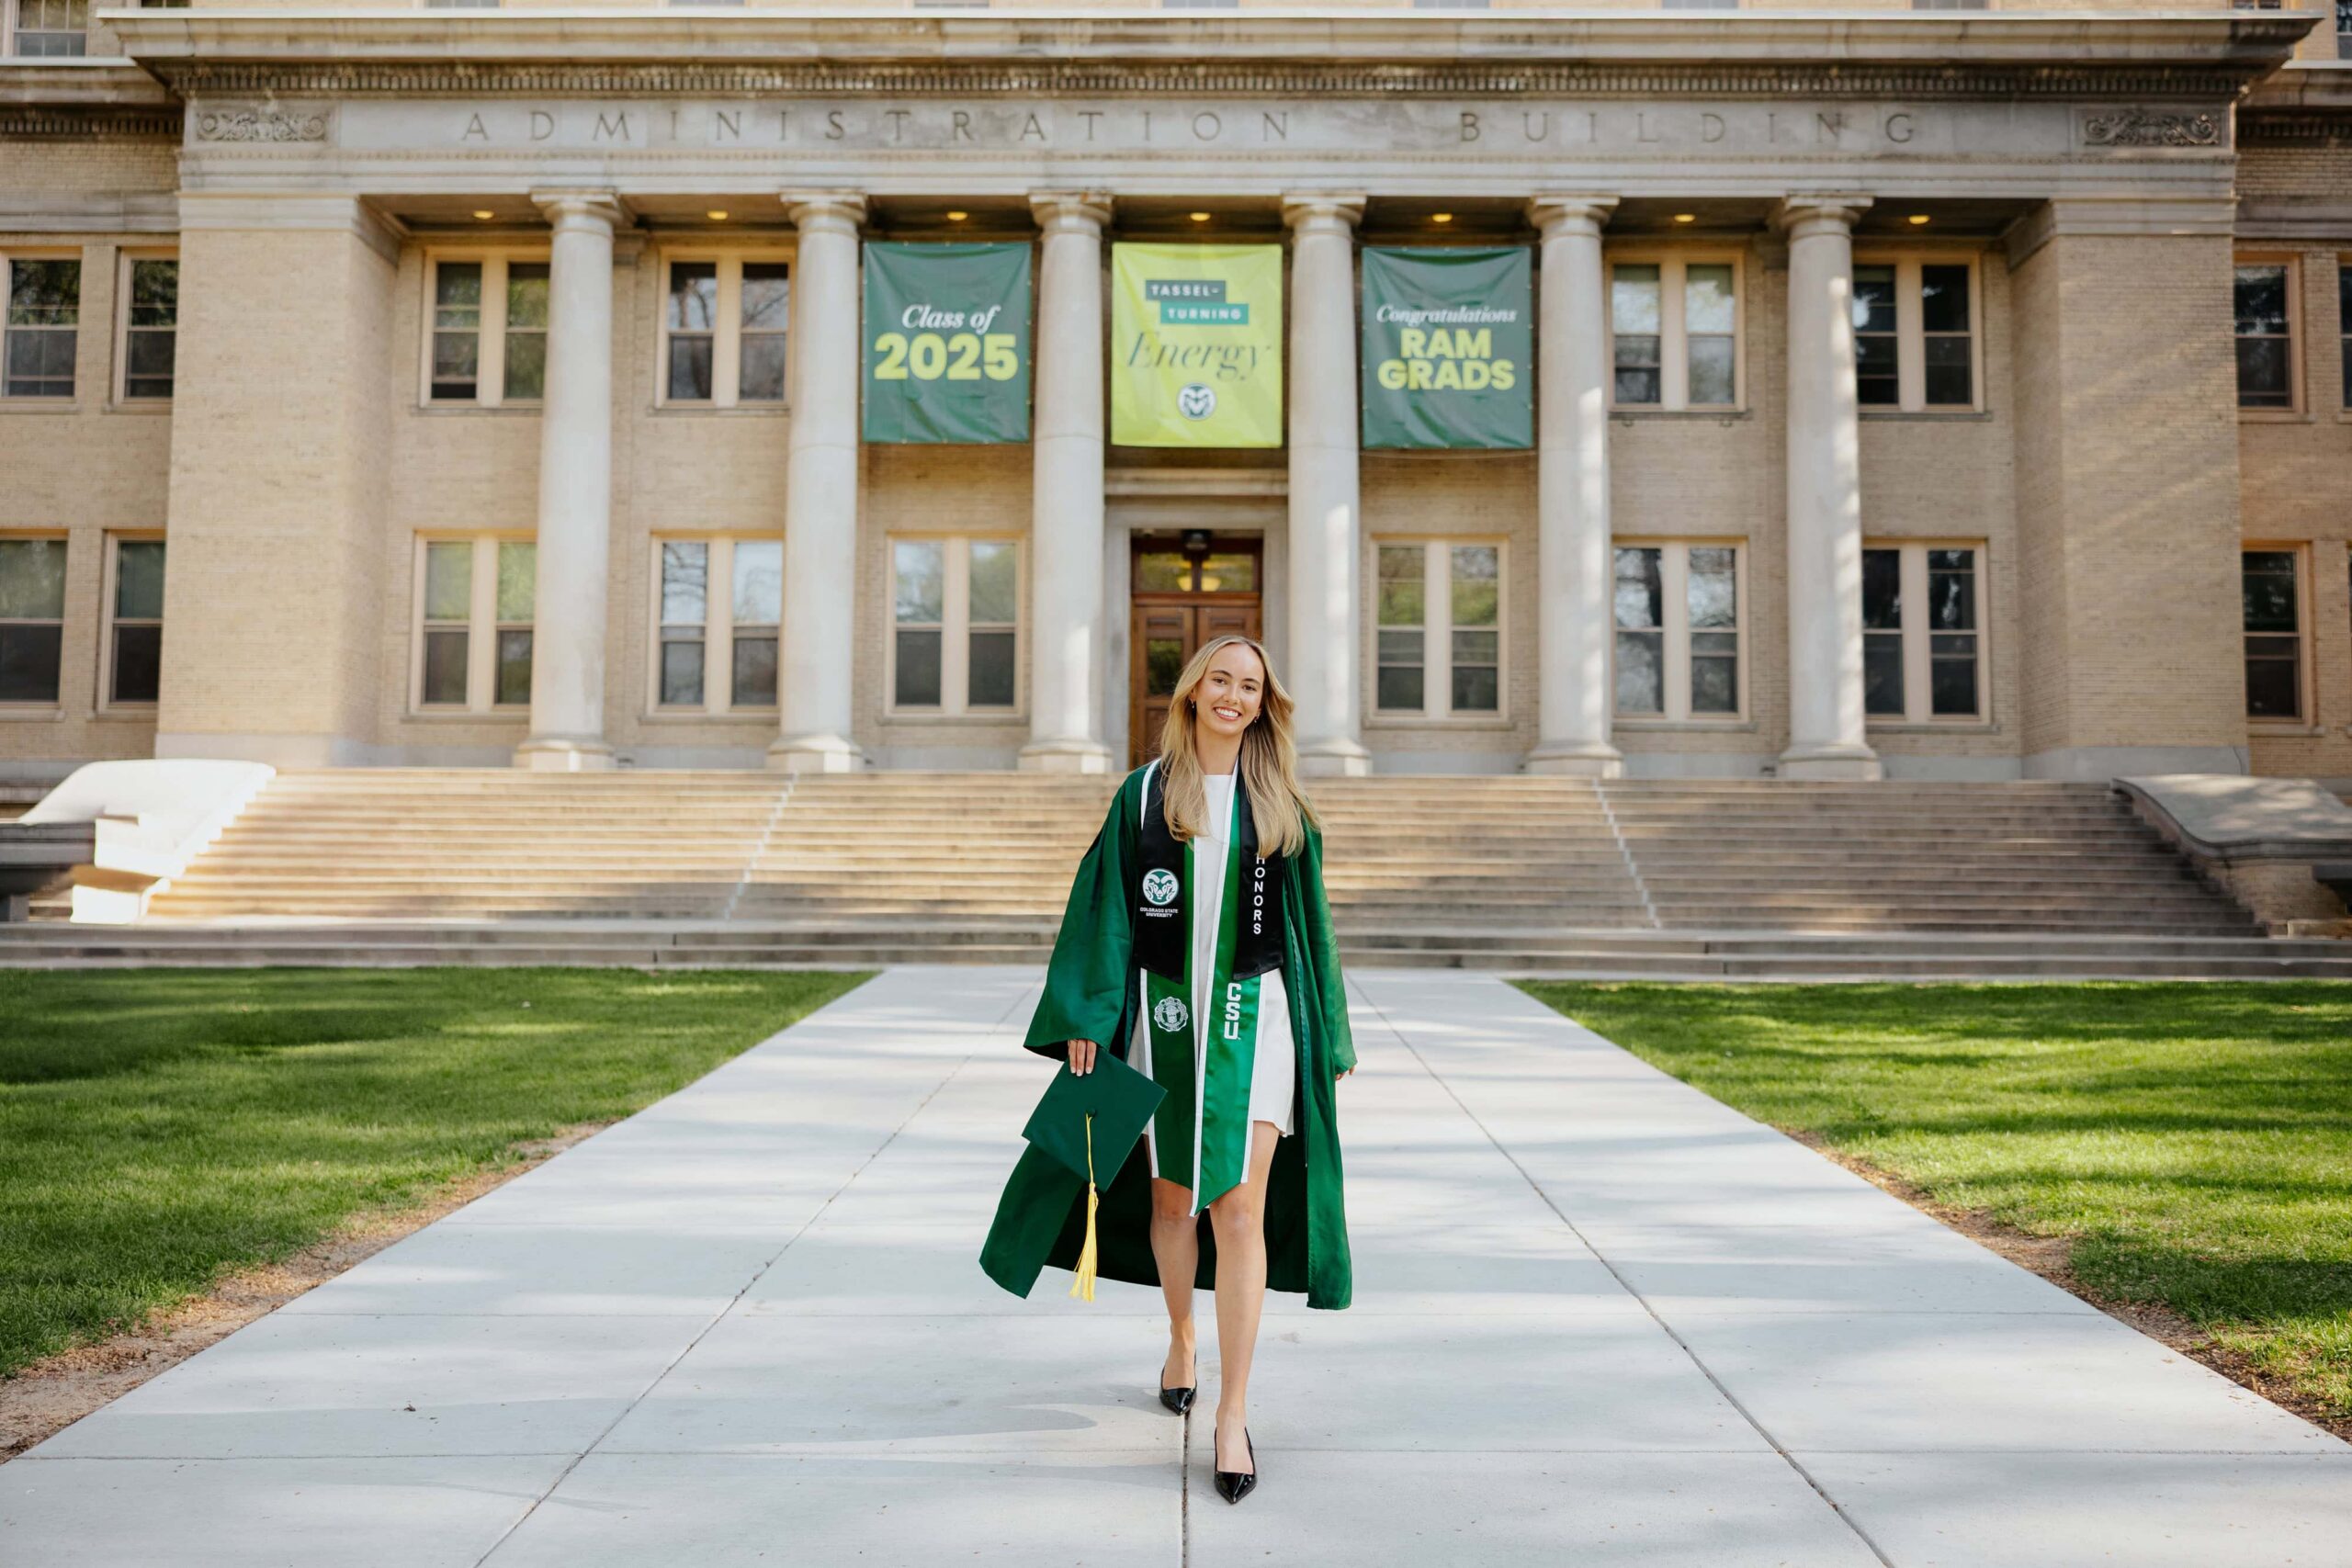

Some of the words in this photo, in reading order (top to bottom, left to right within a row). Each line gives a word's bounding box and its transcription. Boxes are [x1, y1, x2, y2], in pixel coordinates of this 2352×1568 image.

[461, 111, 1288, 142] ADMINISTRATION
[1459, 112, 1915, 143] BUILDING
[1150, 284, 1220, 297] TASSEL-
[901, 304, 965, 329] Class
[969, 304, 1001, 335] of
[1167, 308, 1241, 320] TURNING
[1376, 303, 1518, 328] Congratulations
[874, 332, 1019, 381] 2025
[1128, 332, 1272, 382] Energy
[1400, 328, 1492, 359] RAM
[1378, 359, 1516, 390] GRADS
[1223, 982, 1242, 1040] CSU
